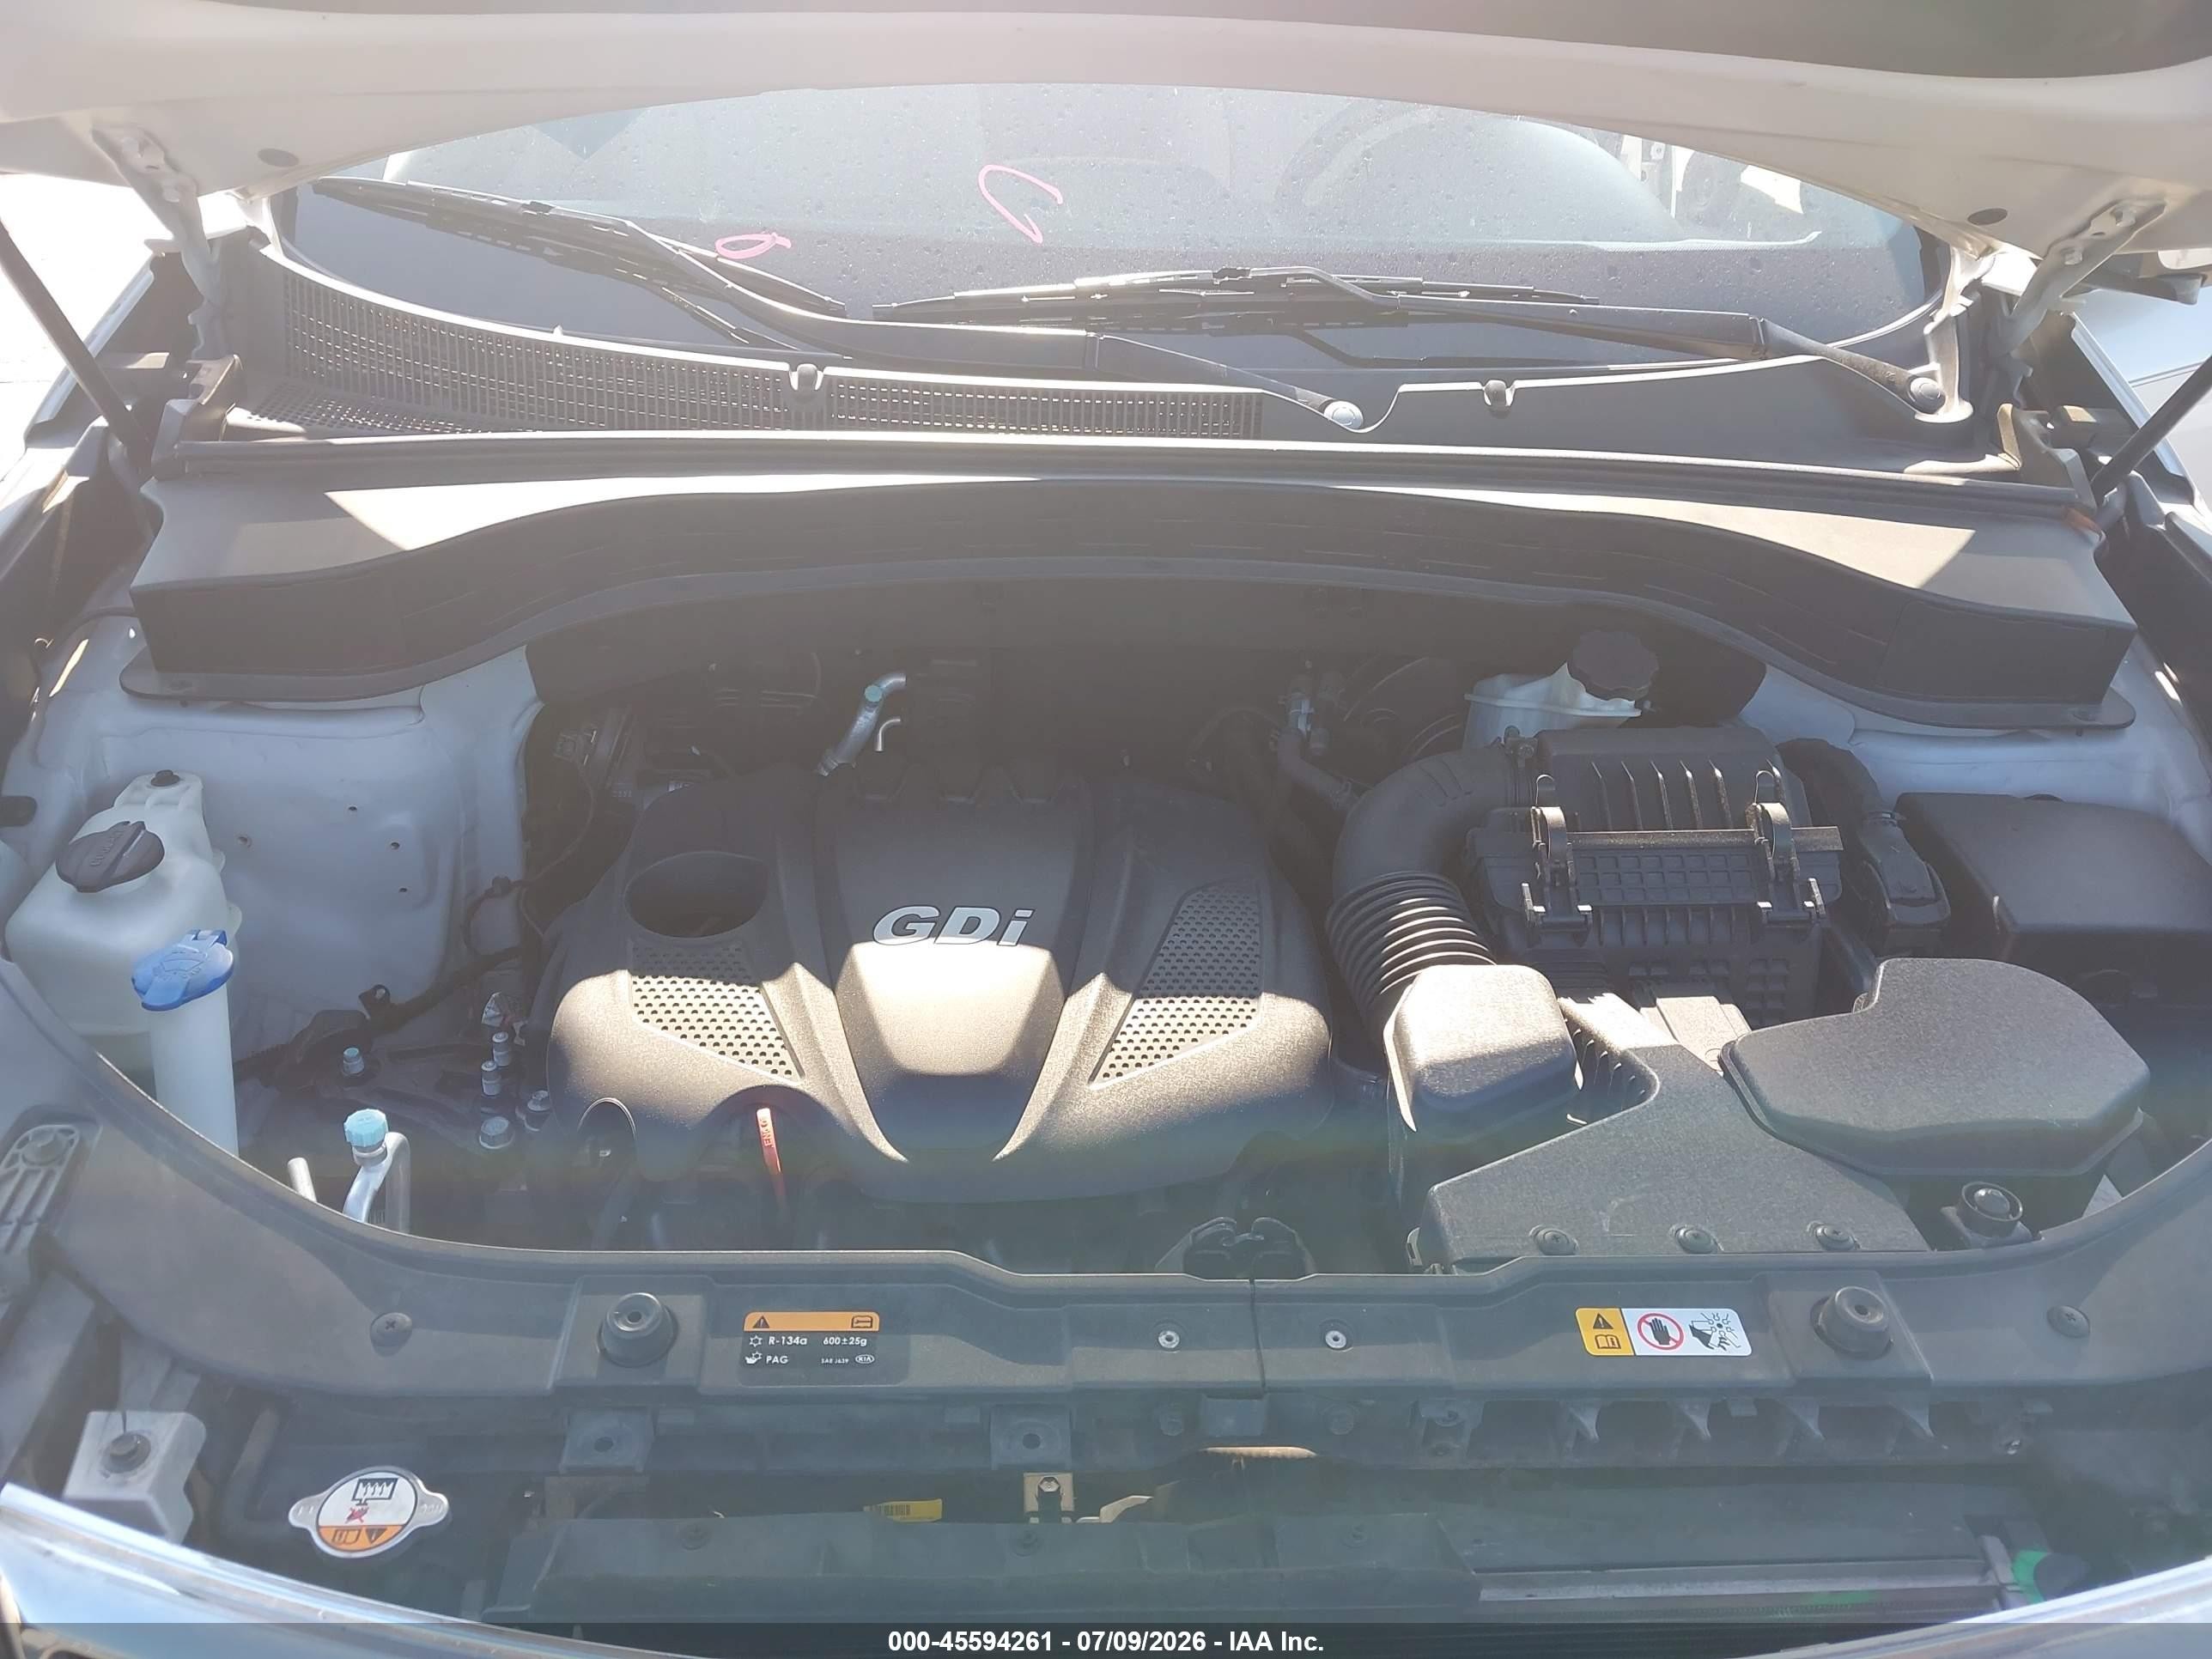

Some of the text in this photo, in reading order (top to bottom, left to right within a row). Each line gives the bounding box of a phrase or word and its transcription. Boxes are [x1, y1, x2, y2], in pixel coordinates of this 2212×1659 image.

[872, 905, 1036, 946] GDi
[768, 1335, 867, 1346] R-134a 600±25g
[766, 1355, 789, 1364] PAG
